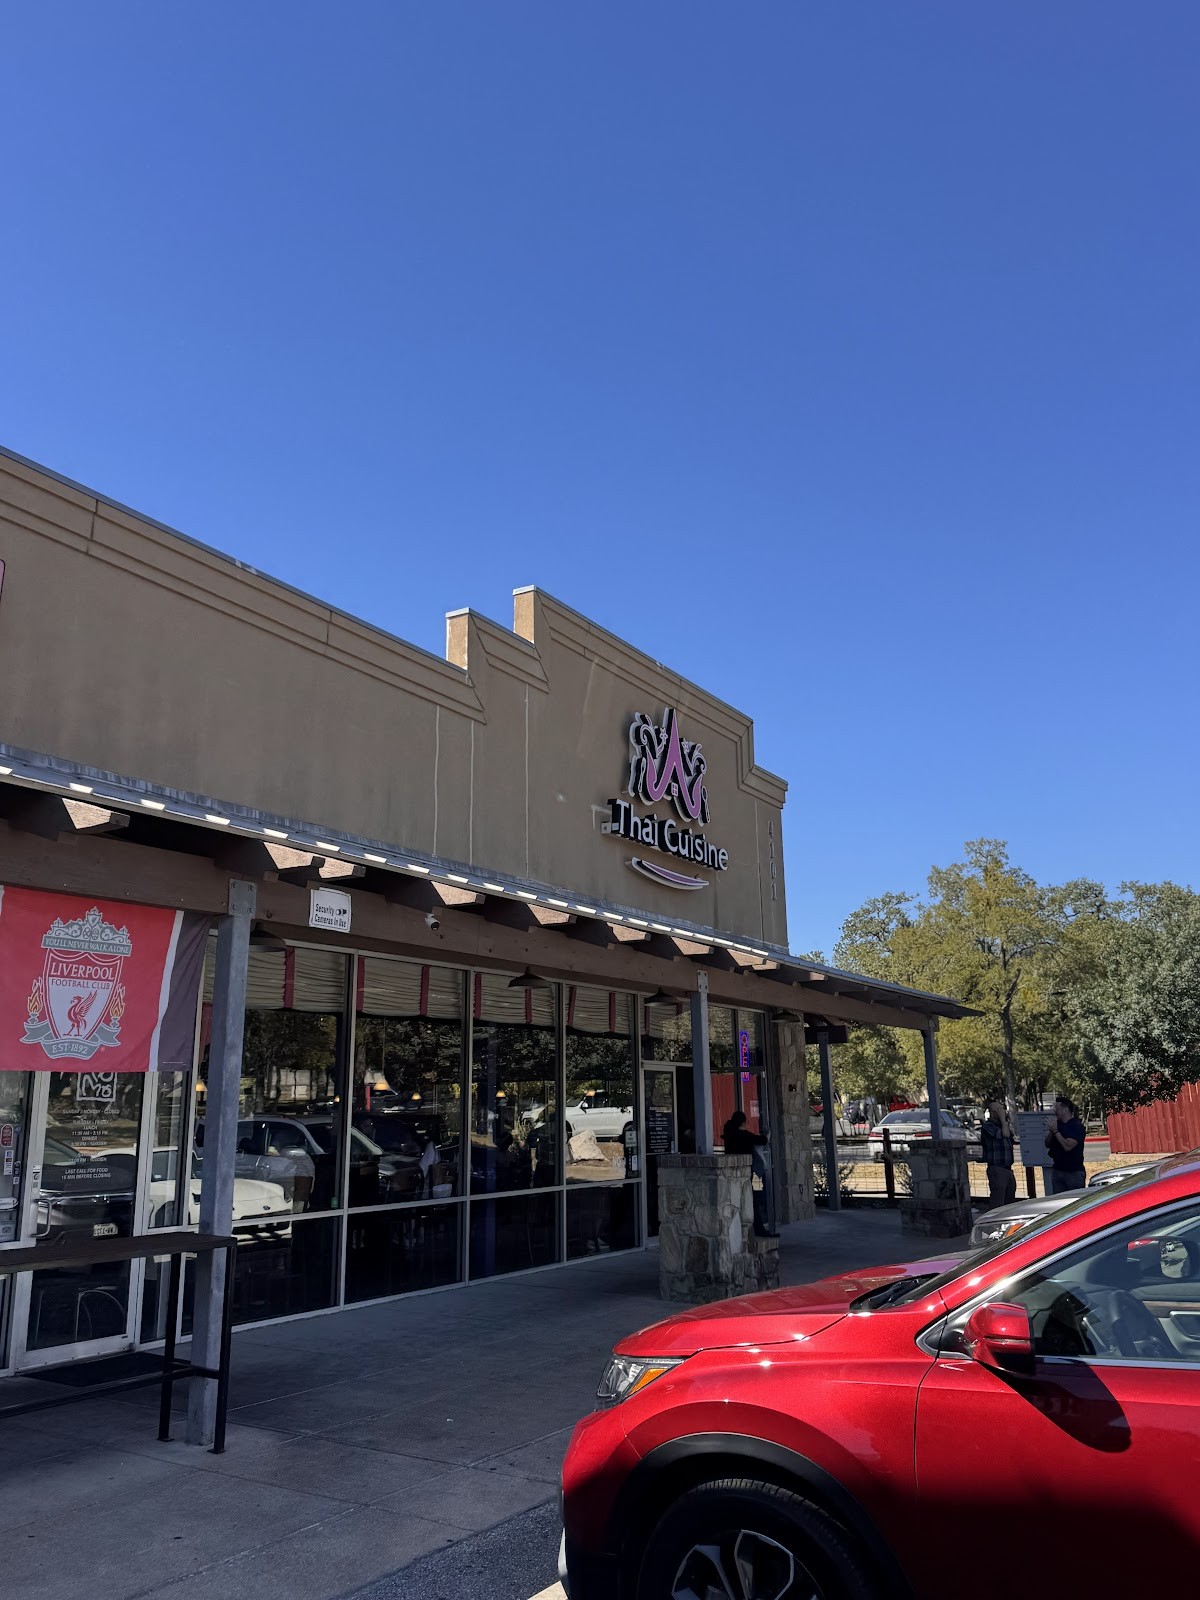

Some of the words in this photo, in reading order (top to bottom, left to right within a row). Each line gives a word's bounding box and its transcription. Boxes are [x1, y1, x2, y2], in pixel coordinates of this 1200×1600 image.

[615, 799, 658, 846] Thai
[664, 819, 729, 870] Cuisine
[768, 820, 777, 900] 4101
[315, 903, 334, 916] Security
[315, 913, 333, 924] Cameras
[67, 940, 89, 950] NEVER
[89, 943, 109, 951] WALK
[109, 945, 129, 954] ALONE
[51, 962, 114, 980] LIVERPOOL
[51, 978, 90, 989] FOOTBALL
[91, 981, 110, 990] CLUB
